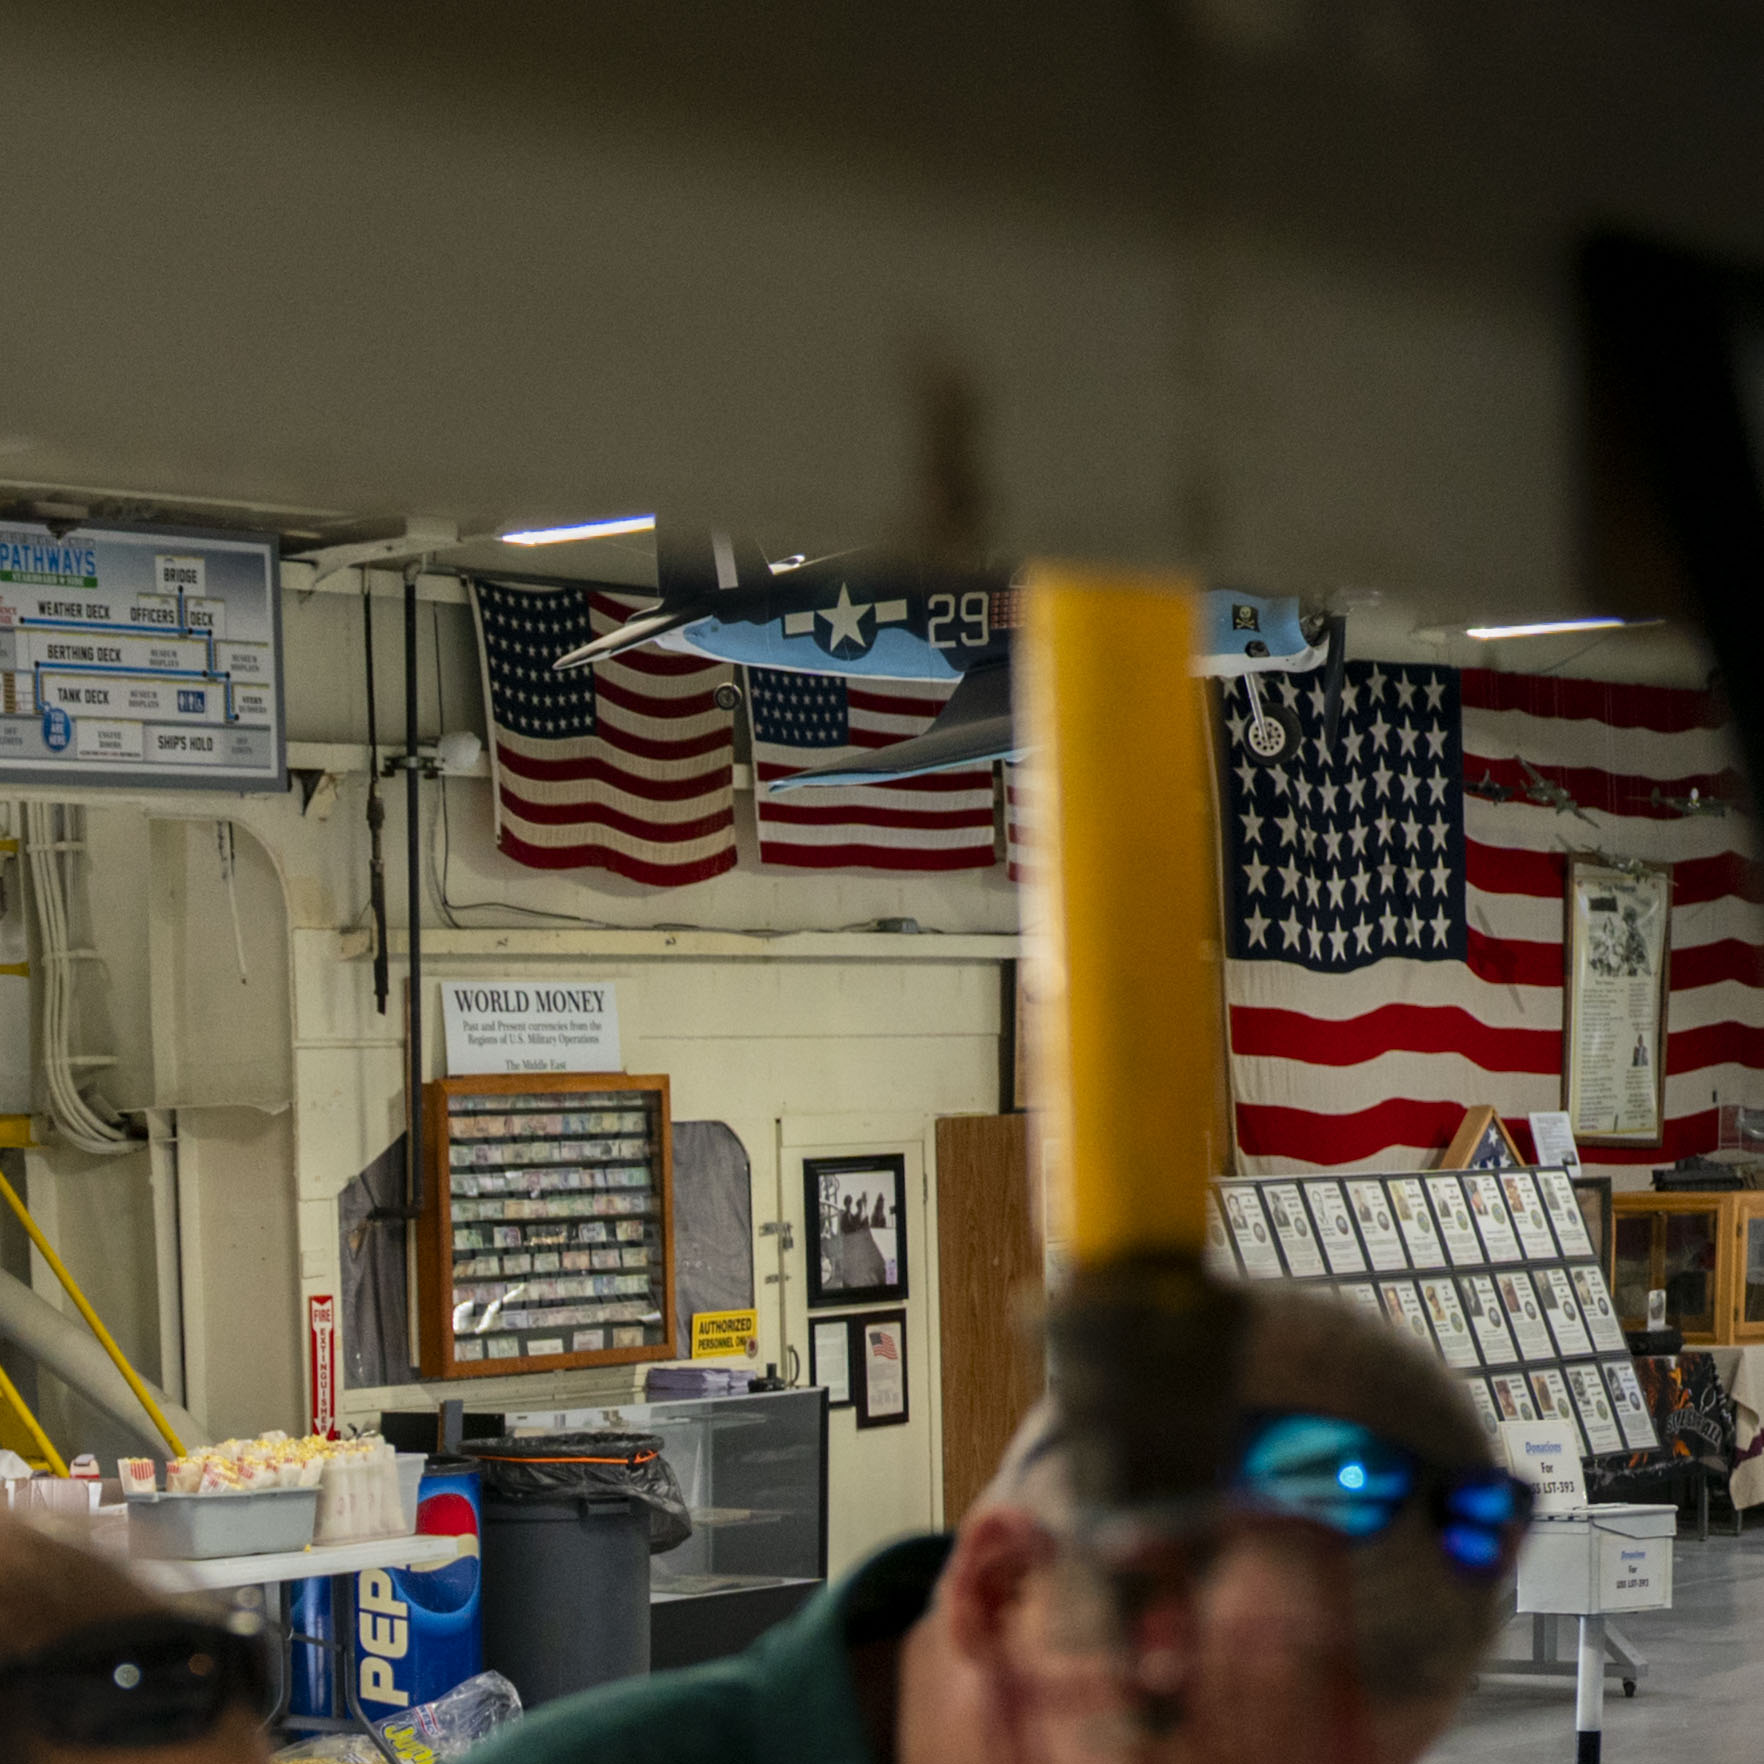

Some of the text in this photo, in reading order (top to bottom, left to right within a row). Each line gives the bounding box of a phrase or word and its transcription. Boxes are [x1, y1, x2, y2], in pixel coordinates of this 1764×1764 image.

[164, 568, 197, 584] BRIDGE
[38, 601, 111, 619] WEATHER DECK
[130, 607, 214, 626] OFFICERS DECK
[928, 592, 990, 648] 29
[47, 644, 121, 662] BERTHING DECK
[58, 688, 110, 704] TANK DECK
[158, 735, 213, 751] SHIP'S HOLD
[454, 990, 604, 1013] WORLD MONEY
[463, 1021, 602, 1031] Past and Present currencies from the
[468, 1035, 498, 1047] Regions
[500, 1034, 508, 1044] of
[528, 1034, 556, 1046] Military
[559, 1034, 599, 1046] Operations
[505, 1060, 566, 1070] The Middle East
[314, 1309, 331, 1322] FIRE
[699, 1318, 752, 1335] AUTHORIZED
[698, 1337, 734, 1350] PERSONNEL
[320, 1328, 328, 1432] EXTINGUISHER
[1525, 1441, 1562, 1454] Donations
[1541, 1462, 1554, 1473] For
[1543, 1481, 1575, 1494] LST-393
[358, 1567, 410, 1708] PEP
